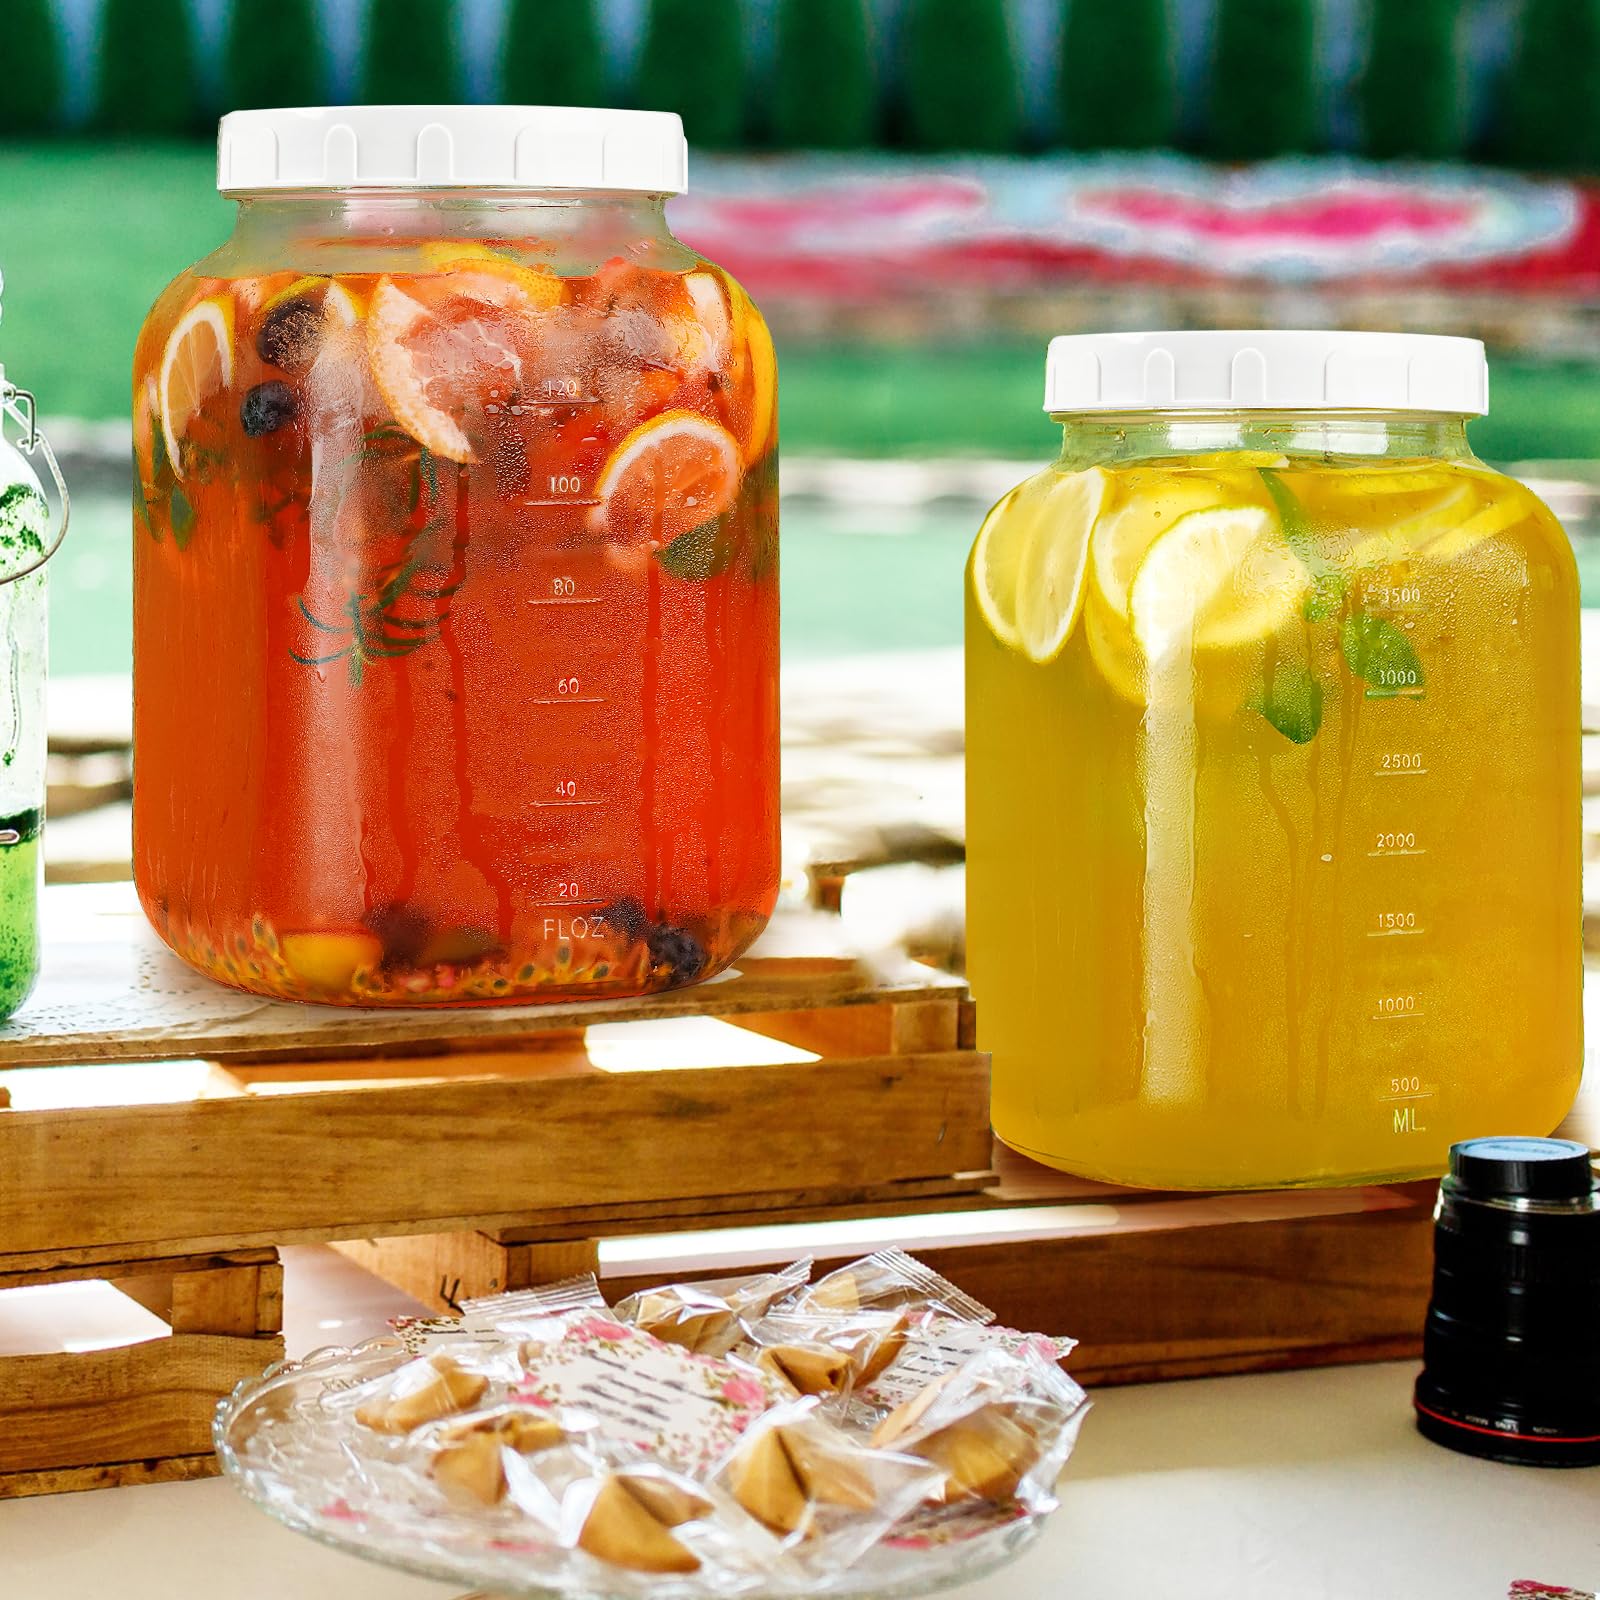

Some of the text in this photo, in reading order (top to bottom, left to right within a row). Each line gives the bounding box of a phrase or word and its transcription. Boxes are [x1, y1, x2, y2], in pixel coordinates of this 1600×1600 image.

[545, 380, 577, 397] 120
[550, 476, 581, 494] 100
[553, 577, 575, 596] 80
[1380, 587, 1421, 603] 3500
[558, 677, 579, 694] 60
[1379, 669, 1417, 685] 3000
[1382, 753, 1421, 769] 2500
[555, 780, 577, 797] 40
[1376, 832, 1415, 848] 2000
[558, 882, 579, 898] 20
[1378, 912, 1416, 929] 1500
[1377, 995, 1414, 1013] 1000
[1390, 1076, 1420, 1093] 500
[1393, 1107, 1426, 1134] ML
